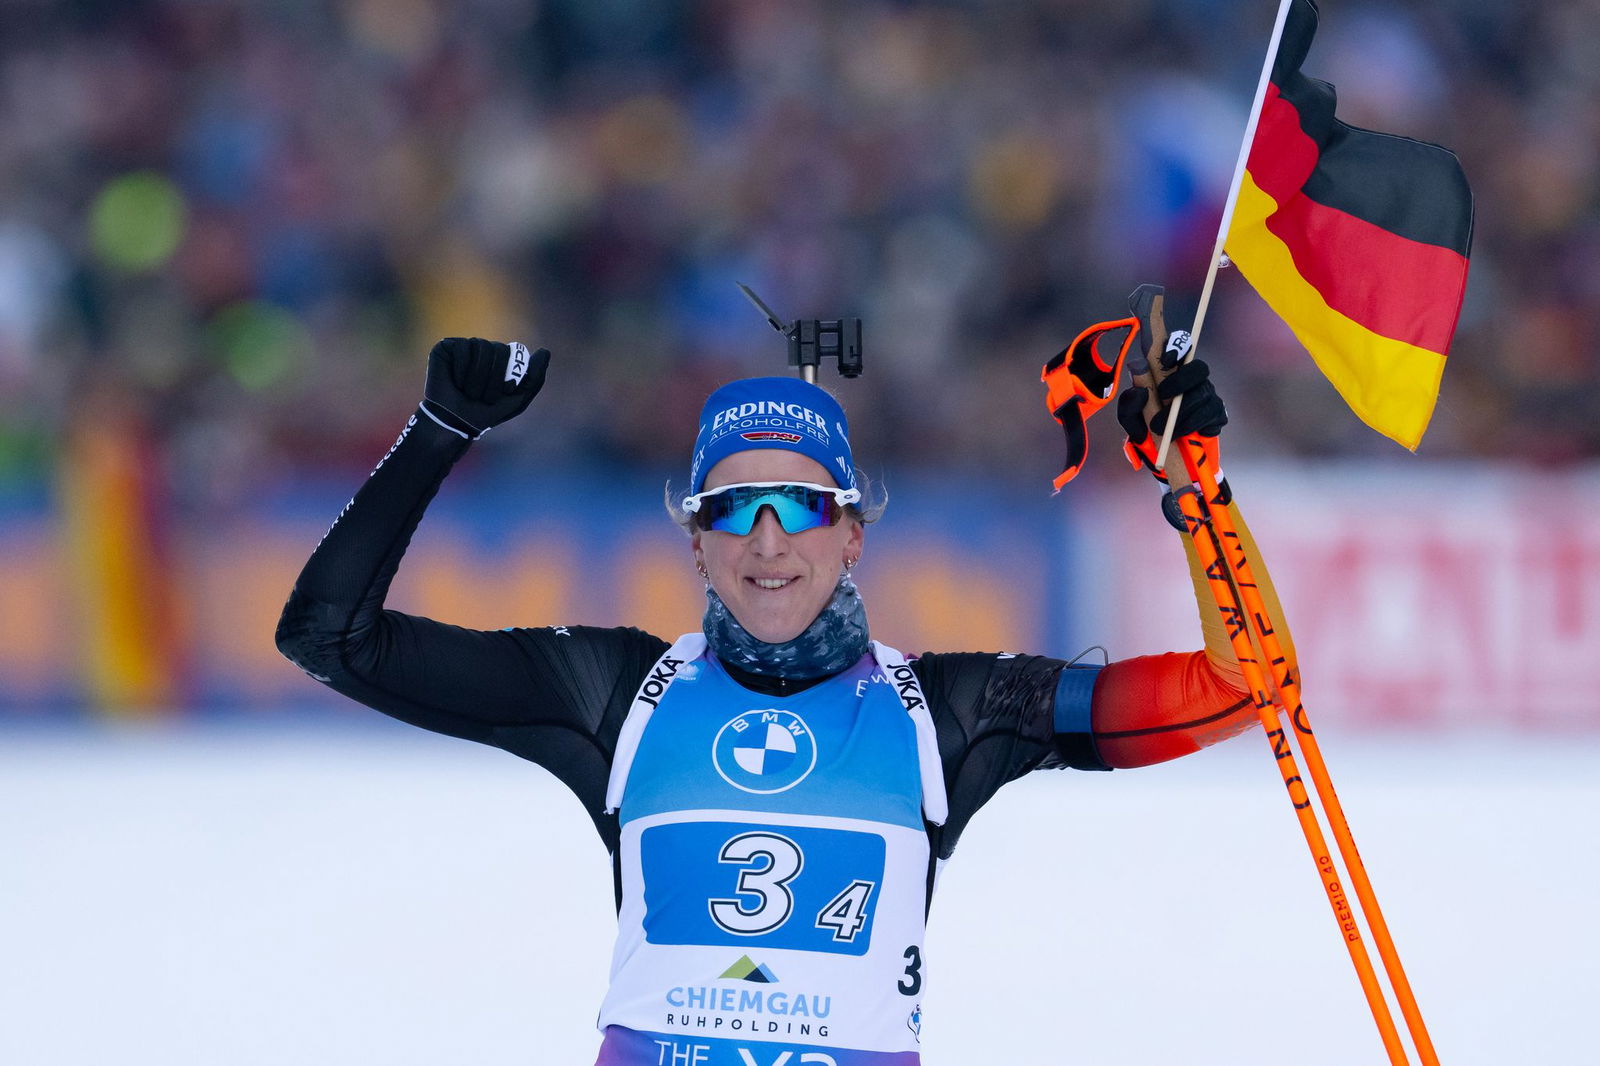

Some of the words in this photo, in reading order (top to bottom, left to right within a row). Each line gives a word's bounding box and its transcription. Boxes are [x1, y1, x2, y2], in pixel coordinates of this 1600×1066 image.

[709, 418, 830, 446] ALKOHOLFREI
[712, 401, 830, 438] ERDINGER
[731, 712, 806, 737] BMW
[1319, 855, 1332, 874] 40
[708, 831, 804, 936] 3
[814, 879, 876, 943] 4
[1329, 881, 1359, 942] PREMIO
[897, 945, 922, 996] 3
[666, 986, 831, 1019] CHIEMGAU
[667, 1013, 829, 1037] RUHPOLDING
